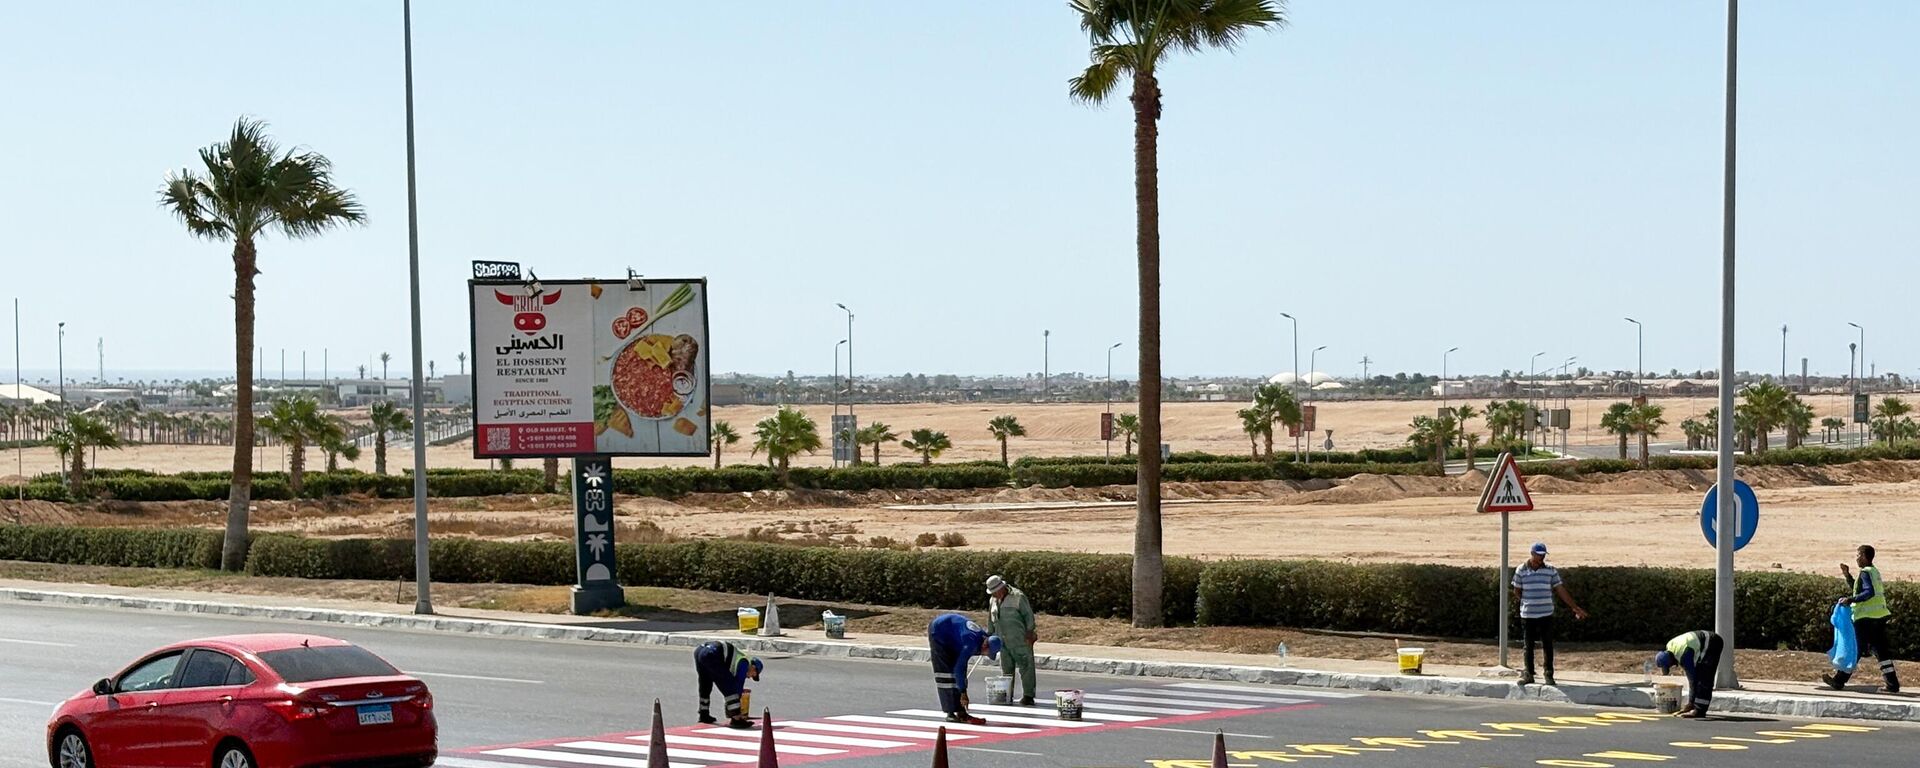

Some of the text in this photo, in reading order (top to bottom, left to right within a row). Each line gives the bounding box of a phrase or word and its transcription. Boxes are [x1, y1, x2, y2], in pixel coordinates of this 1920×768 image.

[496, 357, 566, 366] EL HOSSIENY
[496, 367, 567, 376] RESTAURANT
[537, 398, 573, 406] CUISINE
[1669, 723, 1881, 750] SLOW
